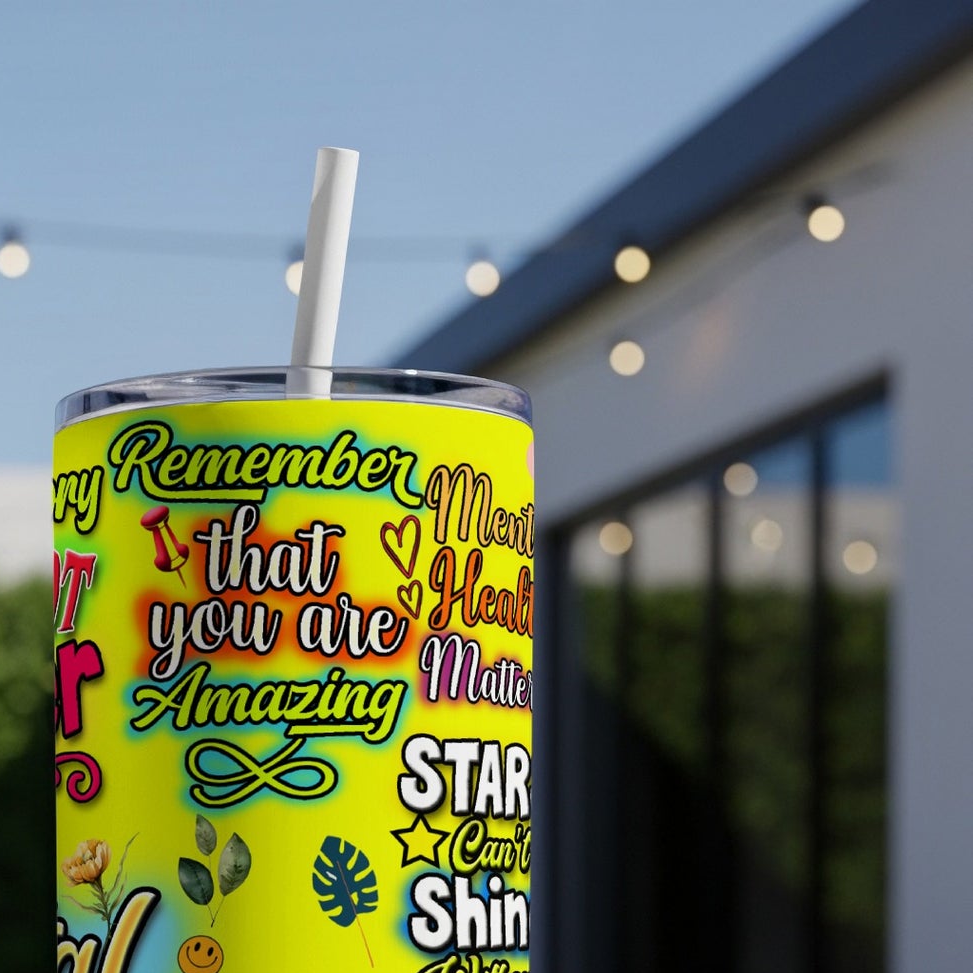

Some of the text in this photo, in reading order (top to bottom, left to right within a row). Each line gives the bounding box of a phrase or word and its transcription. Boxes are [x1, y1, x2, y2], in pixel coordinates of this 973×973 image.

[54, 464, 105, 534] ry
[109, 420, 428, 507] Remember
[195, 503, 345, 596] that
[148, 593, 408, 681] you are
[131, 665, 407, 744] Amazing
